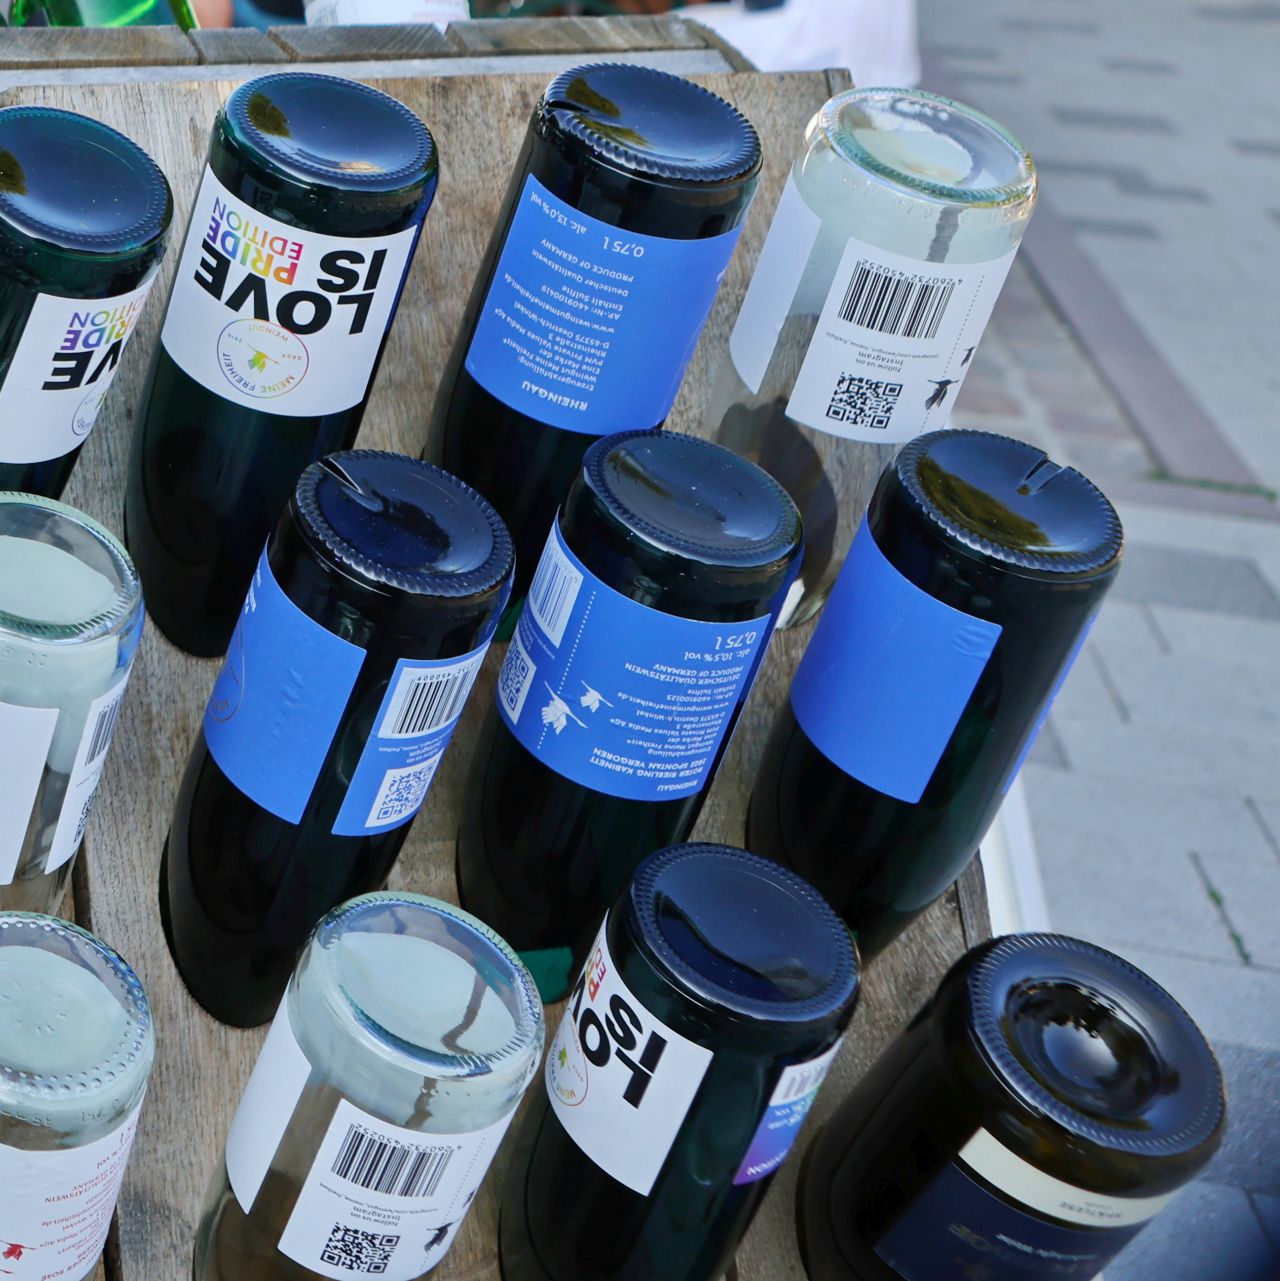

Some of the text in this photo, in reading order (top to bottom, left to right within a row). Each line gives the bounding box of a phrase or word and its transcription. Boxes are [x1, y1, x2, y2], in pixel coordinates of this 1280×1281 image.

[530, 190, 541, 207] vol
[212, 196, 303, 260] EDITION
[569, 219, 586, 235] alc.
[206, 215, 297, 285] PRIDE
[612, 238, 644, 258] 0,75
[316, 248, 387, 293] IS
[540, 238, 633, 282] PRODUCE OF GERMANY
[531, 248, 628, 297] Deutscher Qualitätswein
[862, 259, 952, 284] 260732 450252
[193, 237, 373, 334] LOVE
[561, 285, 623, 311] Enthält Sulfite
[506, 316, 603, 366] PVM Private Values Media
[574, 333, 609, 348] D-65375
[41, 338, 122, 390] VE
[538, 347, 600, 374] Eine Marke der
[858, 350, 903, 366] Instagram
[876, 362, 900, 372] Follow
[222, 352, 294, 392] MEINE FREIHEIT
[534, 356, 597, 383] Weingut Meine
[520, 381, 587, 410] RHEINGAU
[726, 631, 756, 648] 0,75
[683, 648, 750, 661] alc. 10,5 vol
[624, 662, 739, 684] DEUTSCHER QUALITÄTSWEIN
[653, 663, 696, 676] GERMANY
[711, 665, 742, 675] PRODUCE
[628, 722, 652, 732] Media
[589, 755, 702, 777] ROTER RIESLING KABINETT
[593, 747, 645, 767] VERGOREN
[648, 761, 688, 769] SPONTAN
[656, 780, 696, 790] RHEINGAU
[605, 994, 667, 1073] IS
[355, 1122, 400, 1145] 450252
[372, 1217, 397, 1227] Follow
